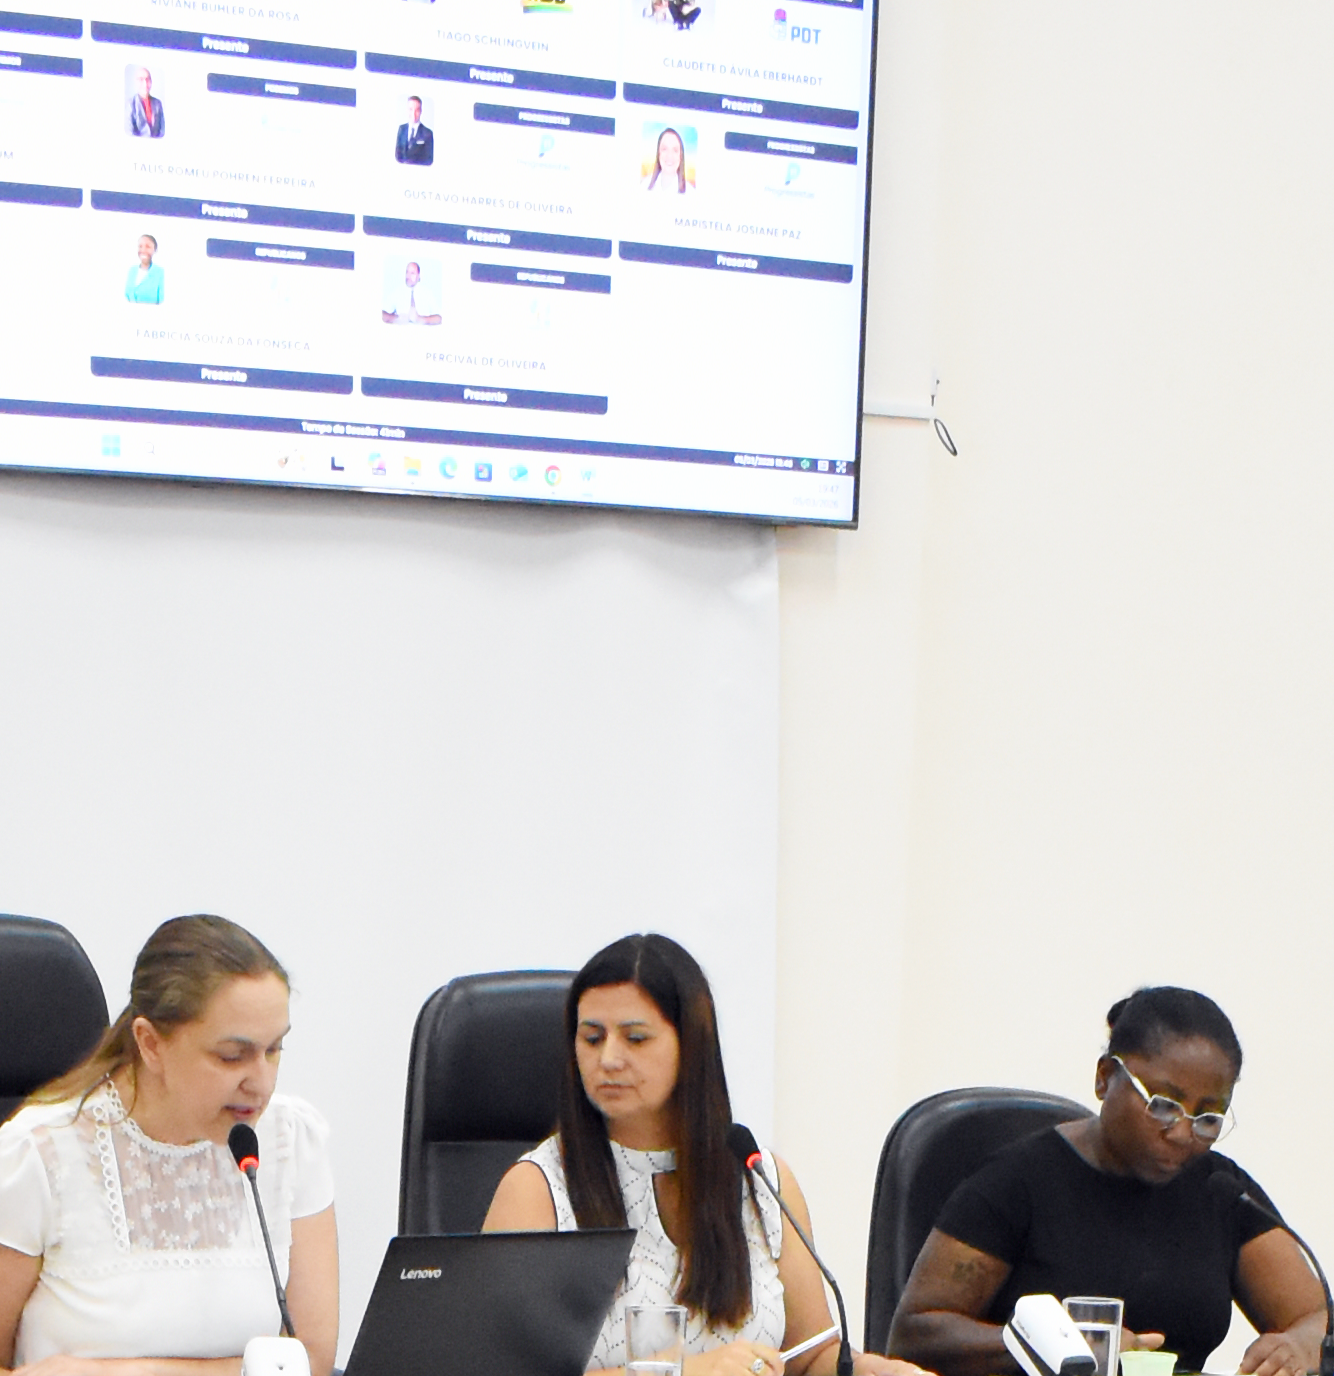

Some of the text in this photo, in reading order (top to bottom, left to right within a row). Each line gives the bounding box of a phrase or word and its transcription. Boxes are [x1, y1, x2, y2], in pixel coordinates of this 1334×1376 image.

[268, 9, 300, 22] ROSA
[436, 29, 472, 43] TIAGO
[790, 25, 822, 45] PDT
[202, 36, 250, 54] Presente
[662, 57, 716, 74] CLAUDETE
[469, 67, 515, 84] Presente
[721, 97, 764, 114] Presente
[133, 162, 164, 175] TALIS
[263, 175, 316, 189] FERREIRA
[403, 189, 459, 204] GUSTAVO
[508, 200, 521, 210] DE
[524, 201, 573, 215] OLIVEIRA
[201, 203, 249, 220] Presente
[466, 229, 511, 245] Presente
[674, 217, 802, 240] MARISTELA JOSIANE PAZ
[716, 253, 759, 270] Presente
[237, 336, 253, 347] DA
[256, 338, 311, 351] FONSECA
[425, 351, 547, 371] PERCIVAL DE OLIVEIRA
[200, 367, 248, 383] Presente
[463, 387, 508, 404] Presente
[400, 1268, 442, 1280] Lenovo
